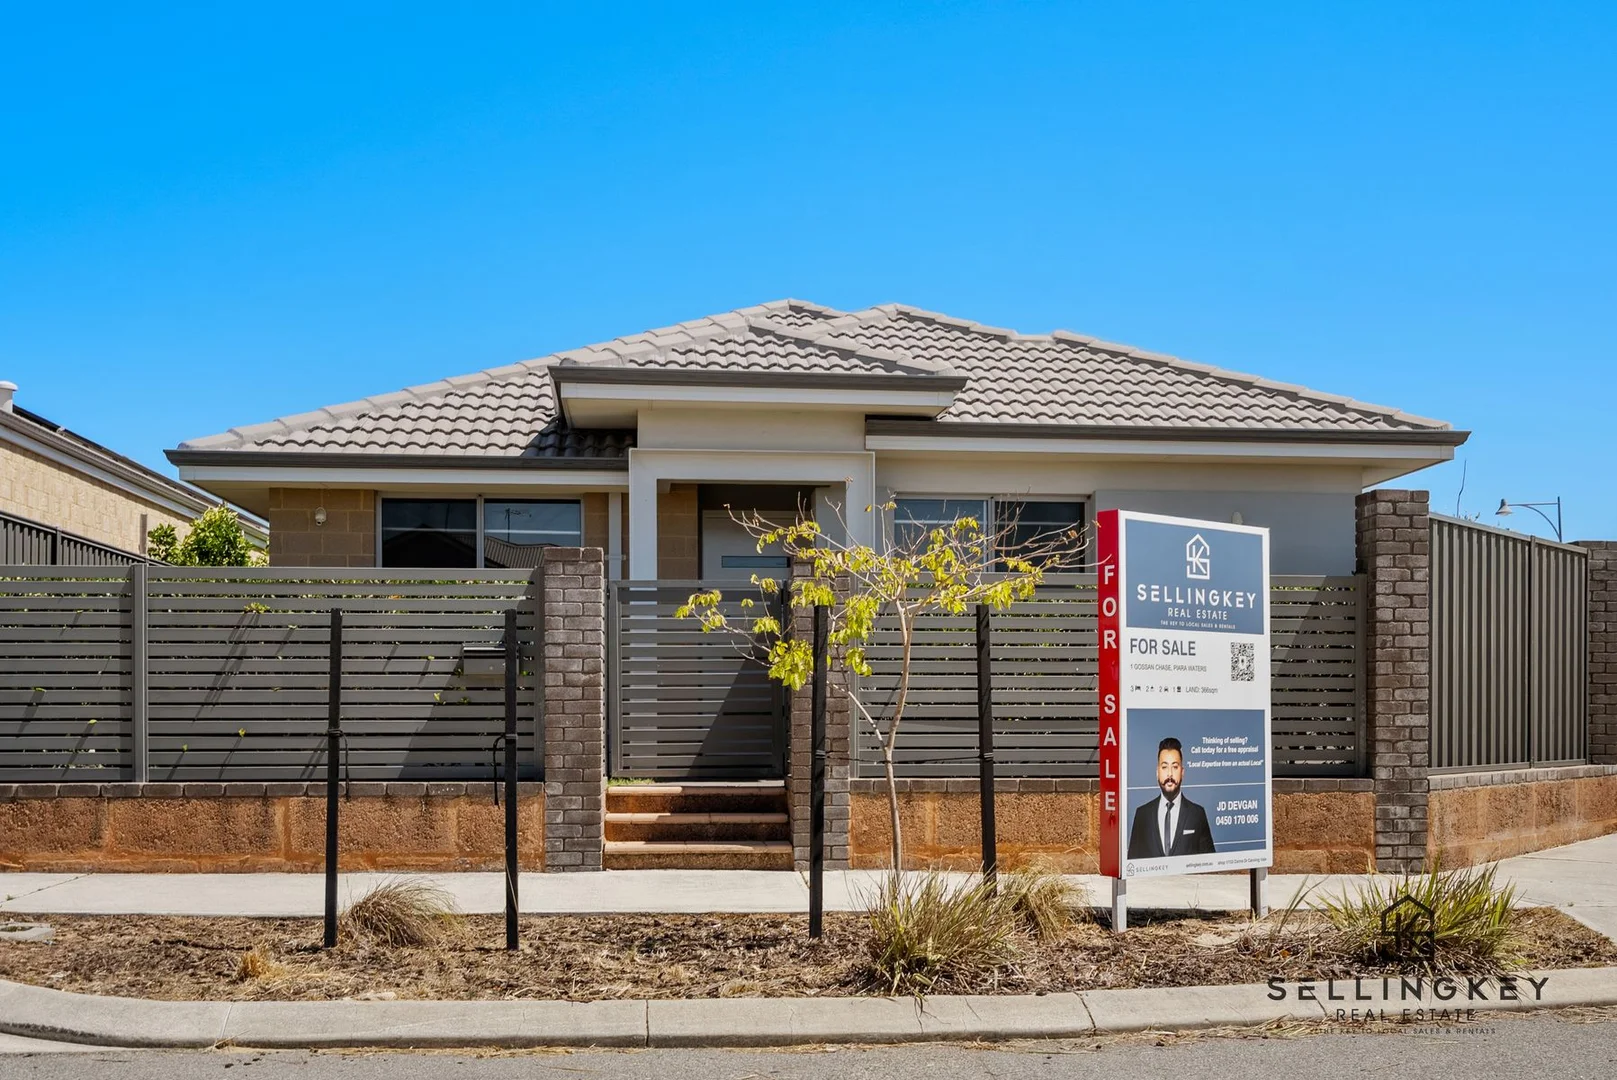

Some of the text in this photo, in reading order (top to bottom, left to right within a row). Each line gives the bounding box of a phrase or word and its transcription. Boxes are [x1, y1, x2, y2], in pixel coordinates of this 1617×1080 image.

[1137, 583, 1256, 609] SELLINGKEY
[1167, 607, 1228, 621] REAL ESTATE
[1130, 638, 1196, 656] FOR SALE
[1202, 737, 1223, 745] Thinking
[1230, 737, 1248, 745] selling?
[1202, 746, 1215, 754] today
[1238, 746, 1258, 754] appraisal
[1216, 800, 1258, 811] JD DEVGAN
[1215, 814, 1259, 826] 0450 170 006
